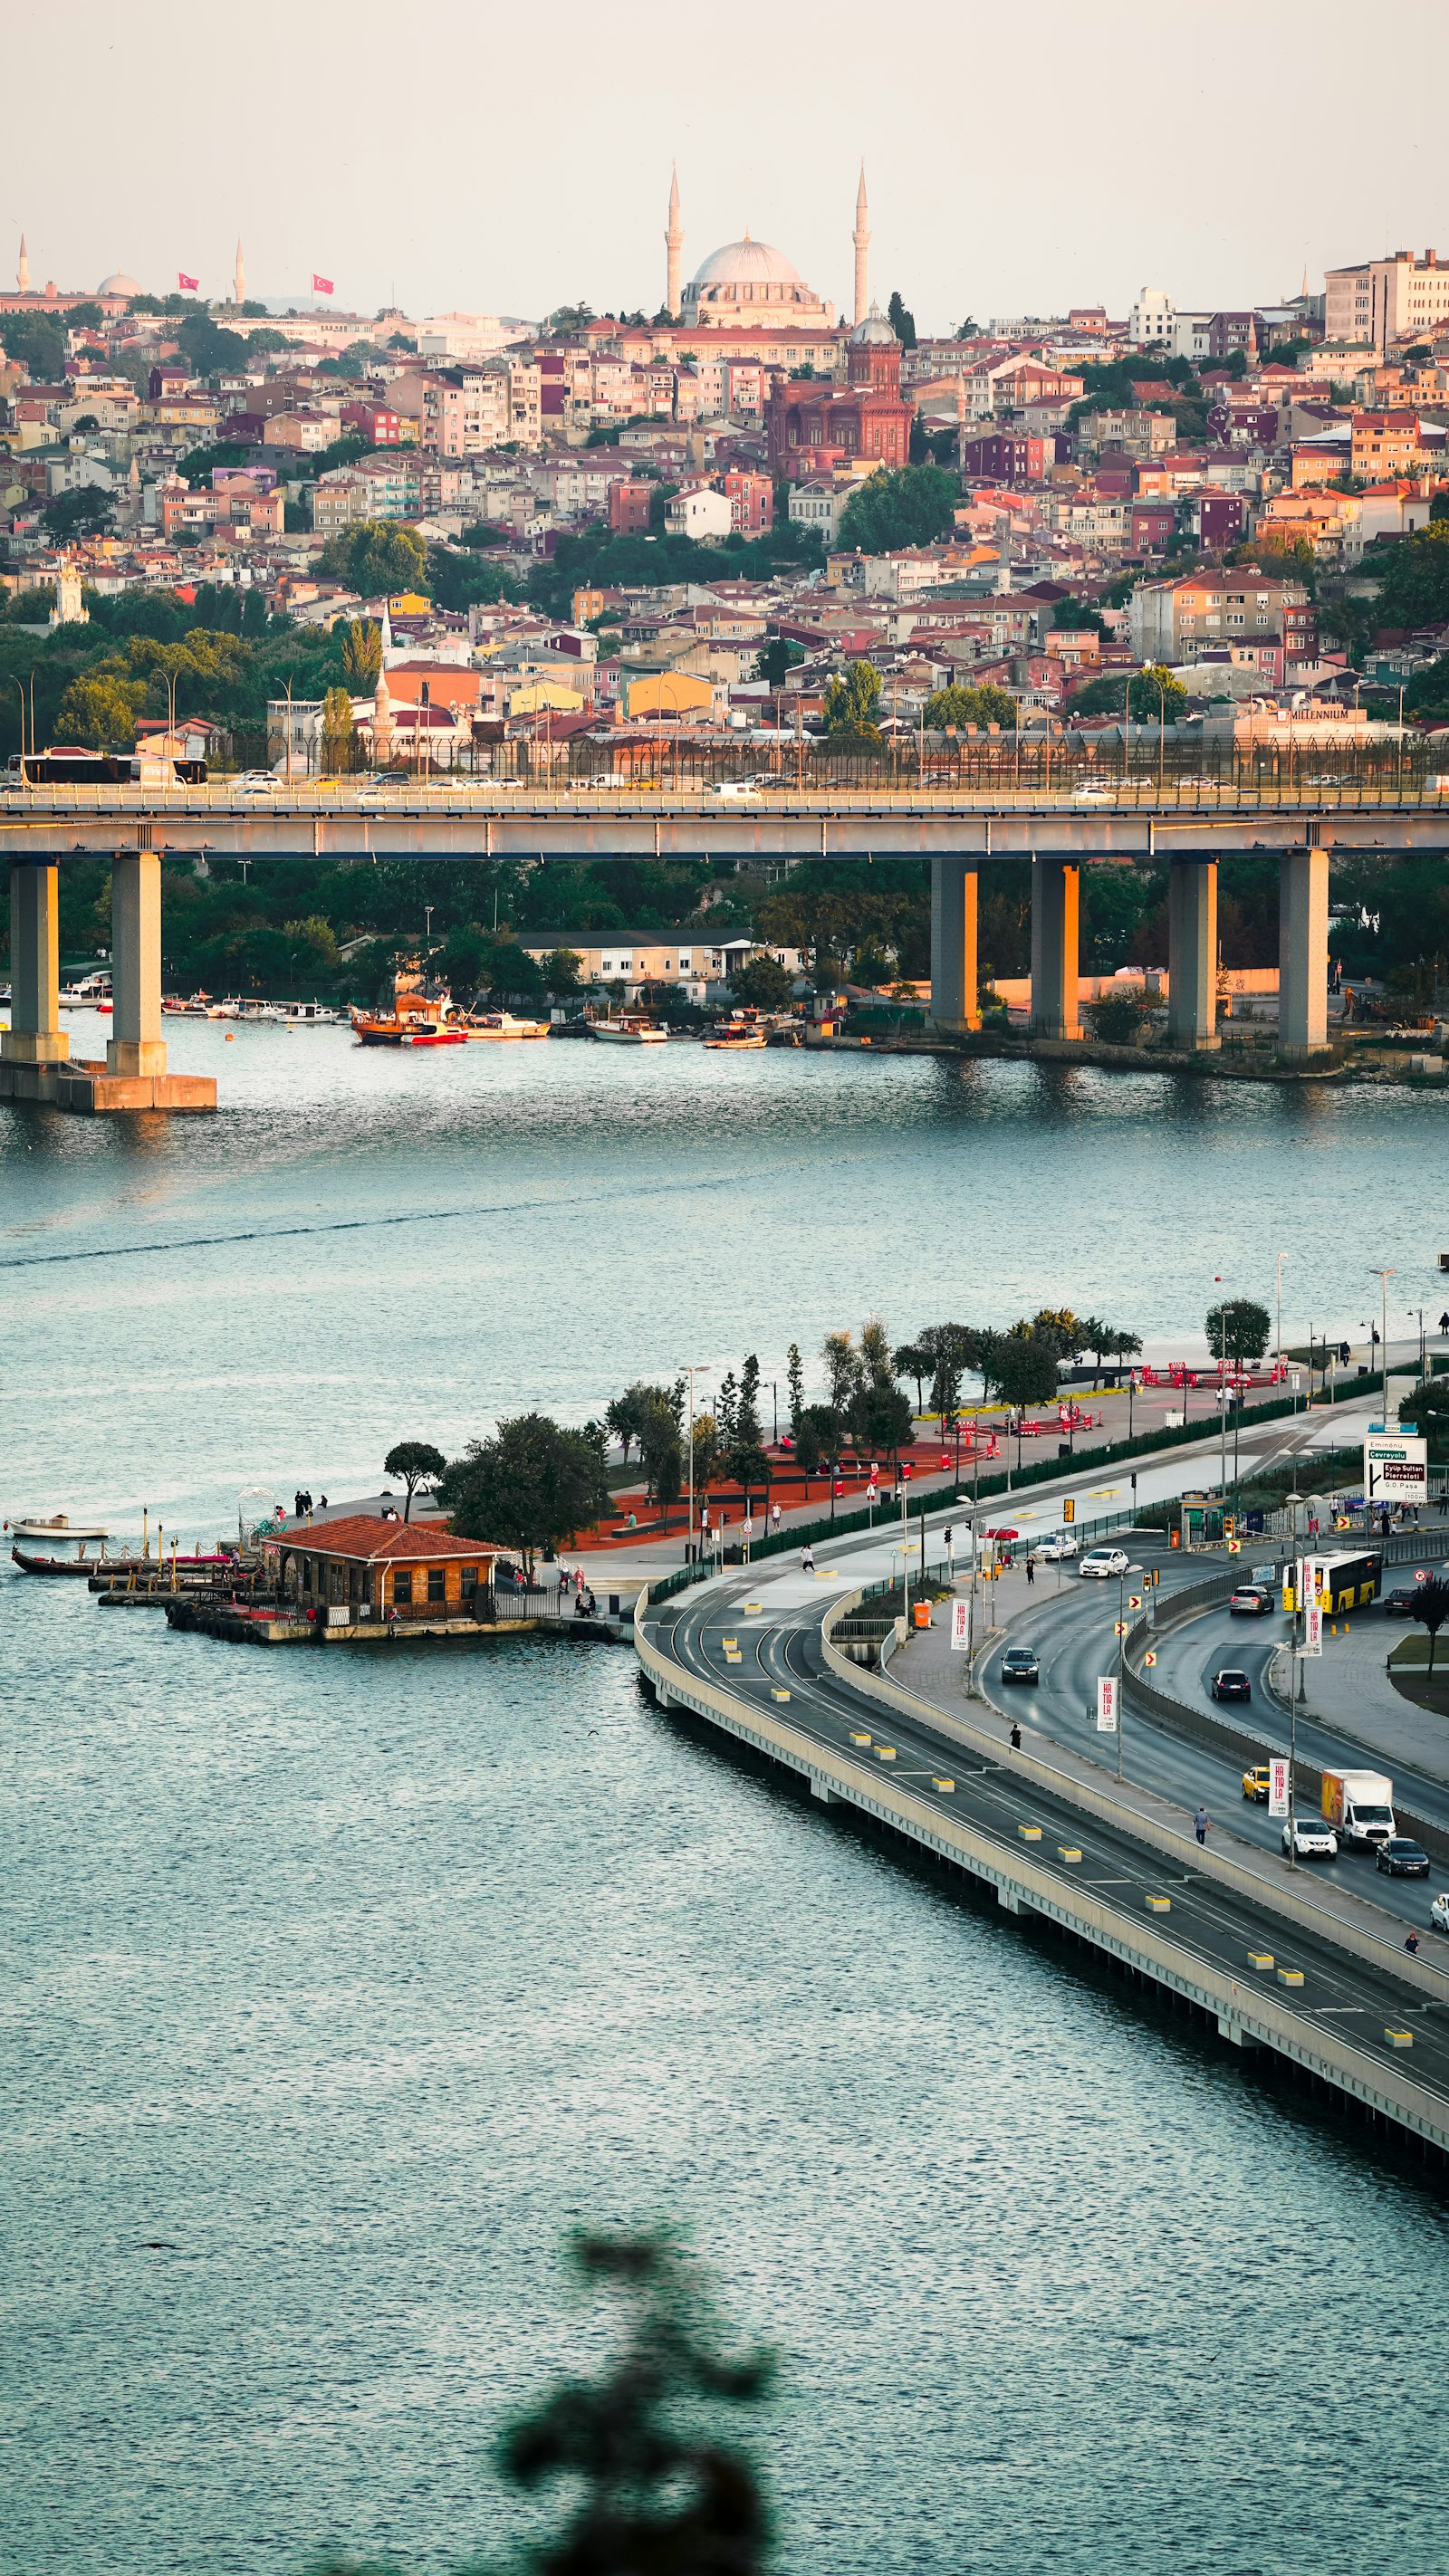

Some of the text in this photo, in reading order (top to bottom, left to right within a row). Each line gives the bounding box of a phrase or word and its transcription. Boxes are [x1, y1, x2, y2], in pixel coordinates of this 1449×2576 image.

[1291, 710, 1348, 720] MILLENNIUM
[1369, 1451, 1406, 1460] Çevreyolu
[957, 1605, 965, 1615] HA
[956, 1615, 965, 1625] TIR
[956, 1626, 964, 1635] LA
[1103, 1683, 1112, 1693] HA
[1102, 1694, 1112, 1704] TIR
[1103, 1705, 1111, 1715] LA
[1275, 1766, 1284, 1776] HA
[1274, 1776, 1284, 1788] TIR
[1275, 1788, 1283, 1799] LA
